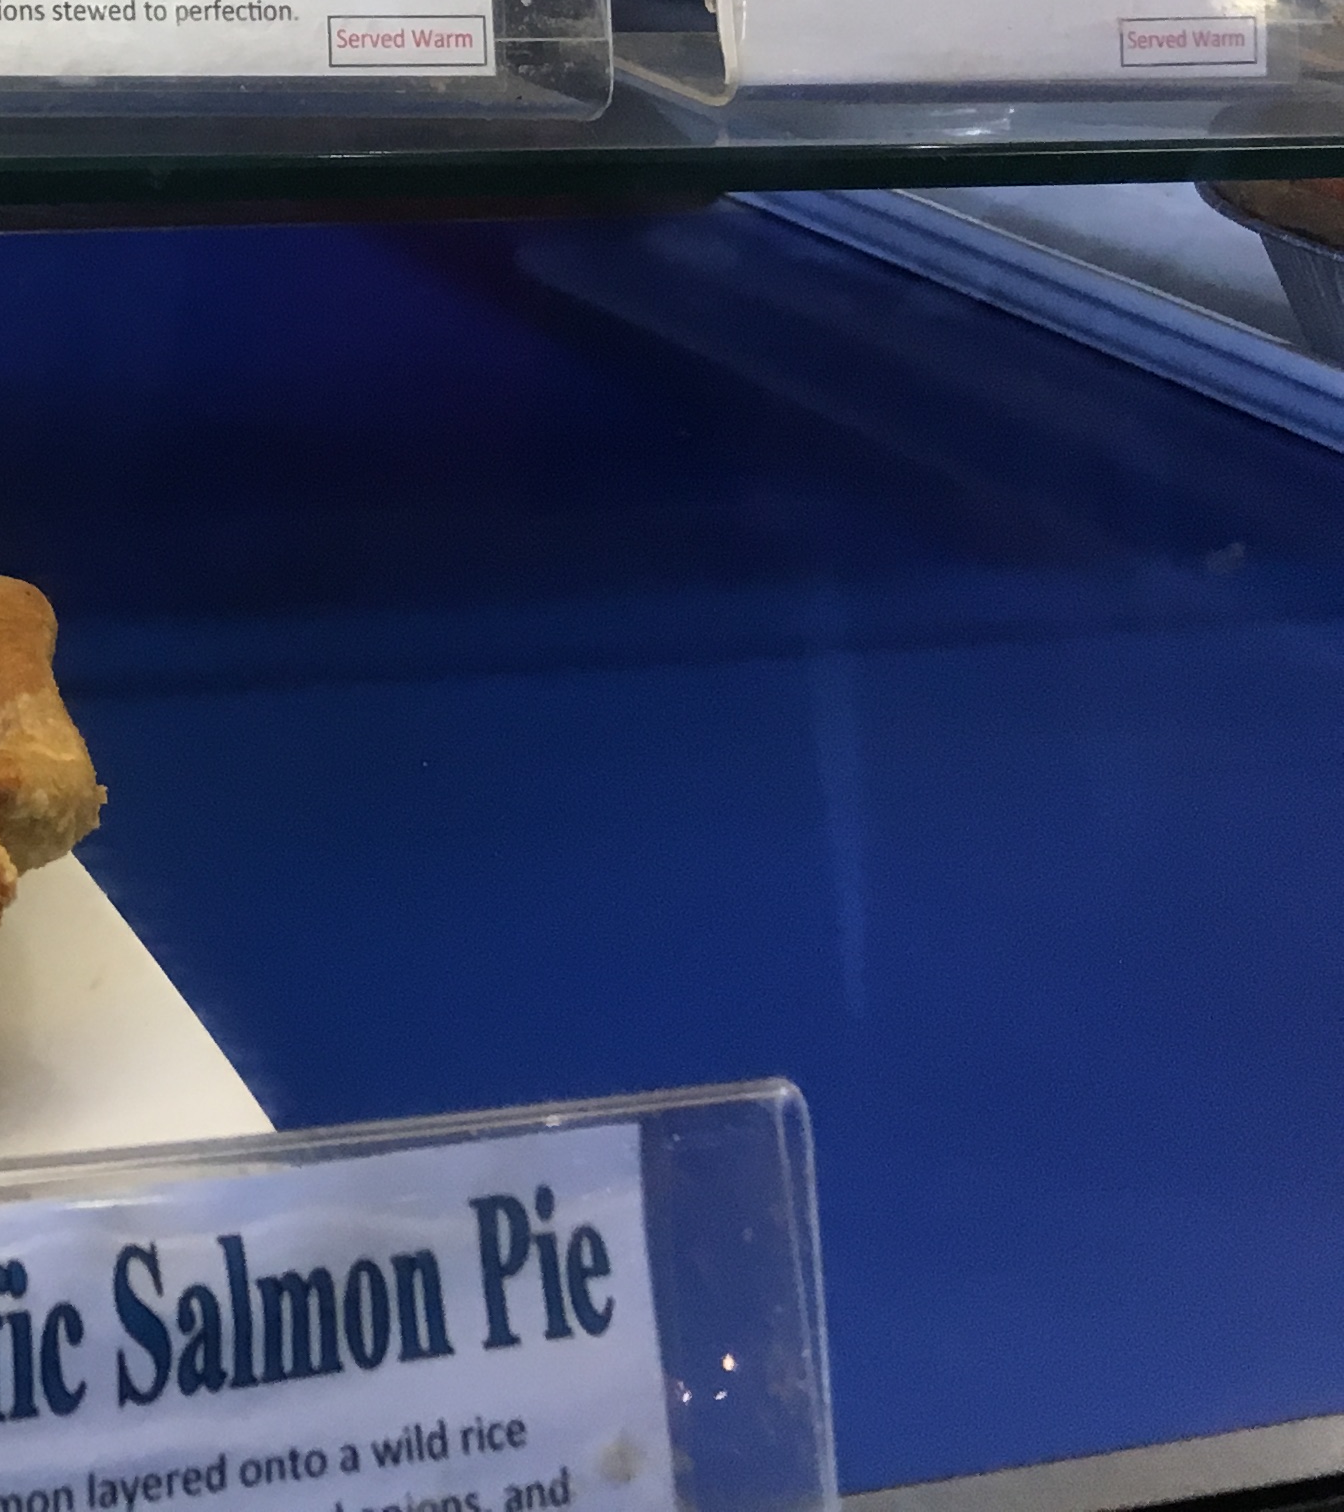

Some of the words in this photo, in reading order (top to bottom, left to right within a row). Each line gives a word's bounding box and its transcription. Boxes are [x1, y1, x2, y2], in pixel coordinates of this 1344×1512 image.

[143, 1, 167, 22] to
[175, 0, 299, 26] perfection.
[336, 28, 406, 49] Served
[411, 29, 474, 49] Warm
[1127, 29, 1188, 50] Served
[1192, 29, 1246, 49] Warm
[113, 1234, 455, 1409] Salmon
[469, 1183, 615, 1354] Pie
[86, 1451, 227, 1511] layered
[238, 1446, 329, 1488] onto
[338, 1441, 361, 1474] a
[370, 1417, 451, 1468] wild
[459, 1415, 528, 1455] rice
[505, 1465, 572, 1512] and
